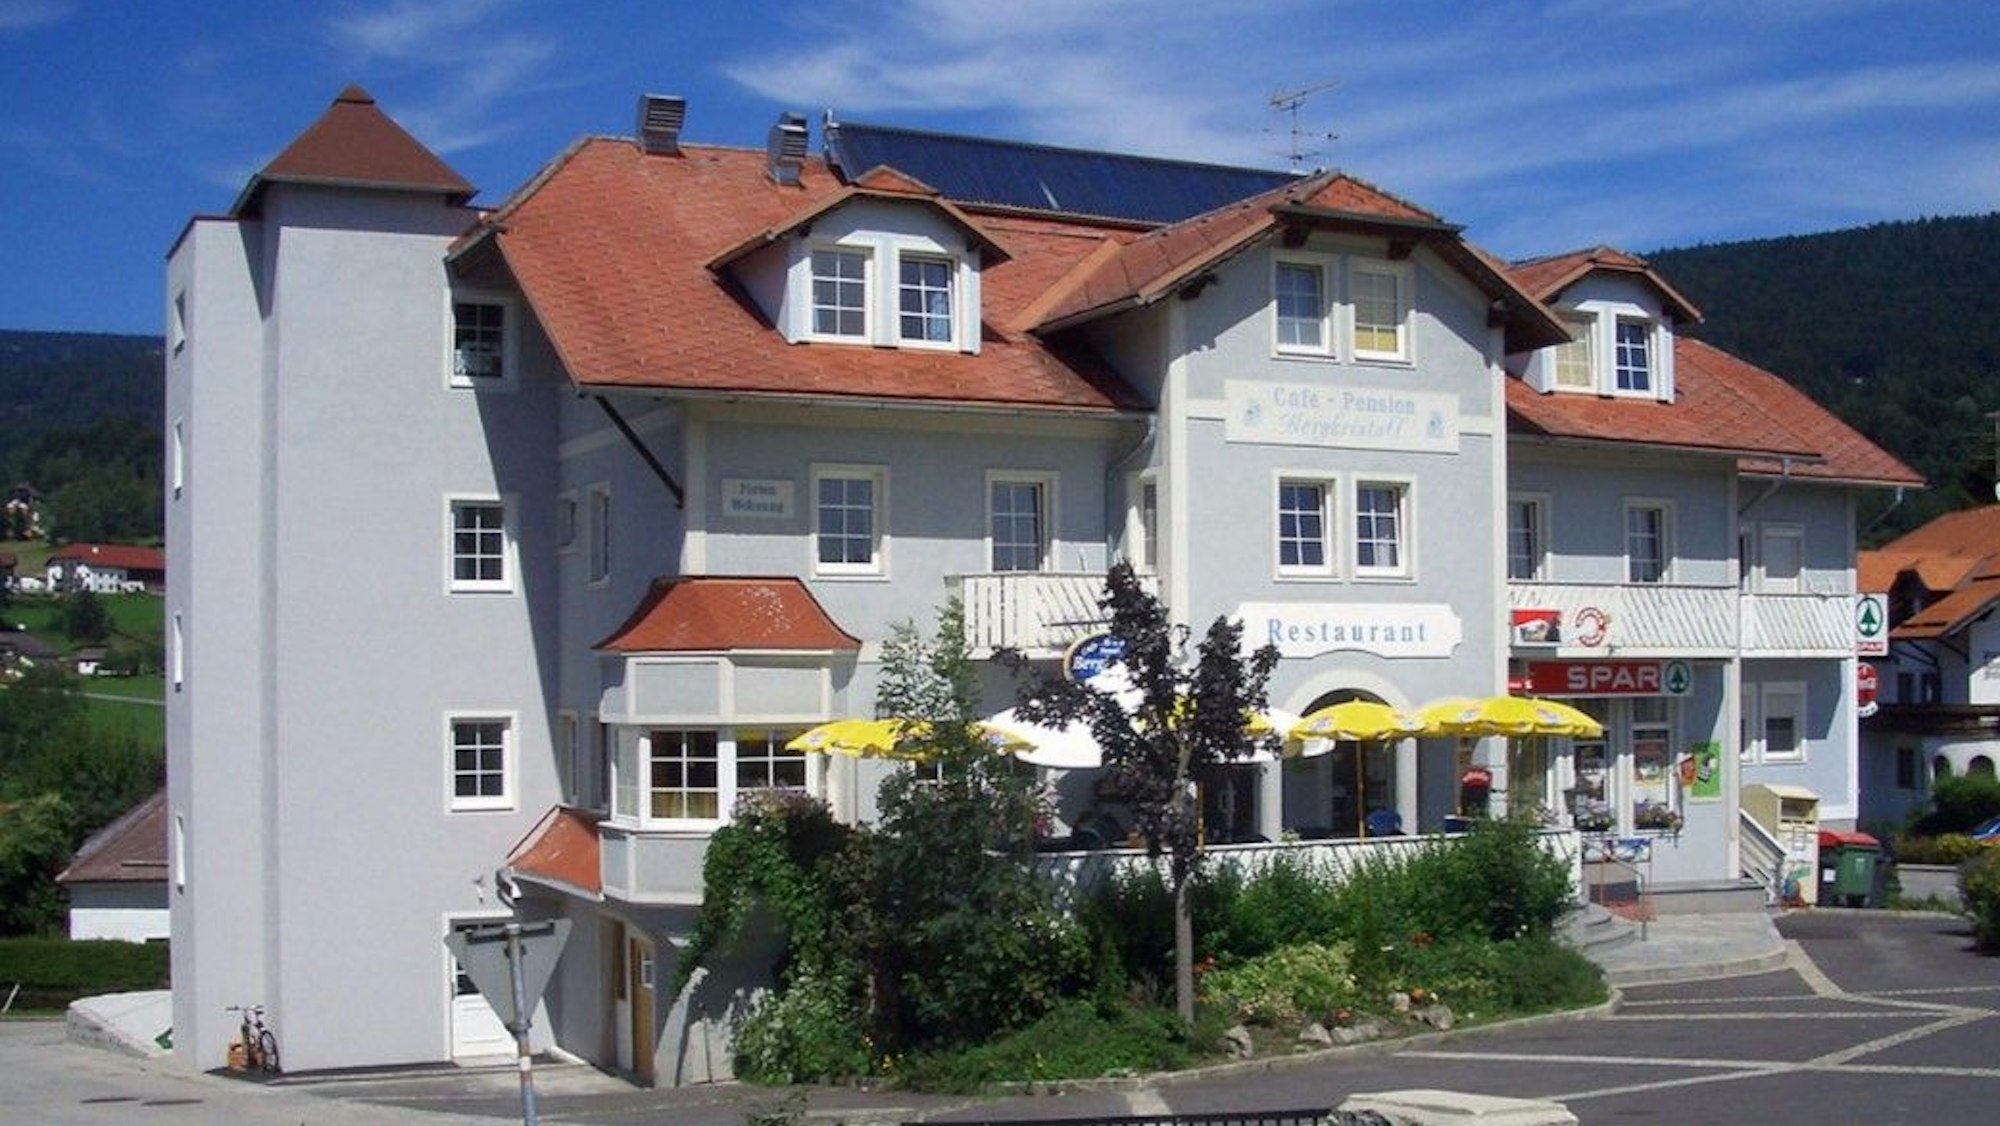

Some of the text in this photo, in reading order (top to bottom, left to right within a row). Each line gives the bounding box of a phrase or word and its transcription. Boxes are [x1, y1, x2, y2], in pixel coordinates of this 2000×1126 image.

[1342, 391, 1416, 415] Pension
[1267, 617, 1428, 643] Restaurant
[1566, 665, 1660, 690] SPAR
